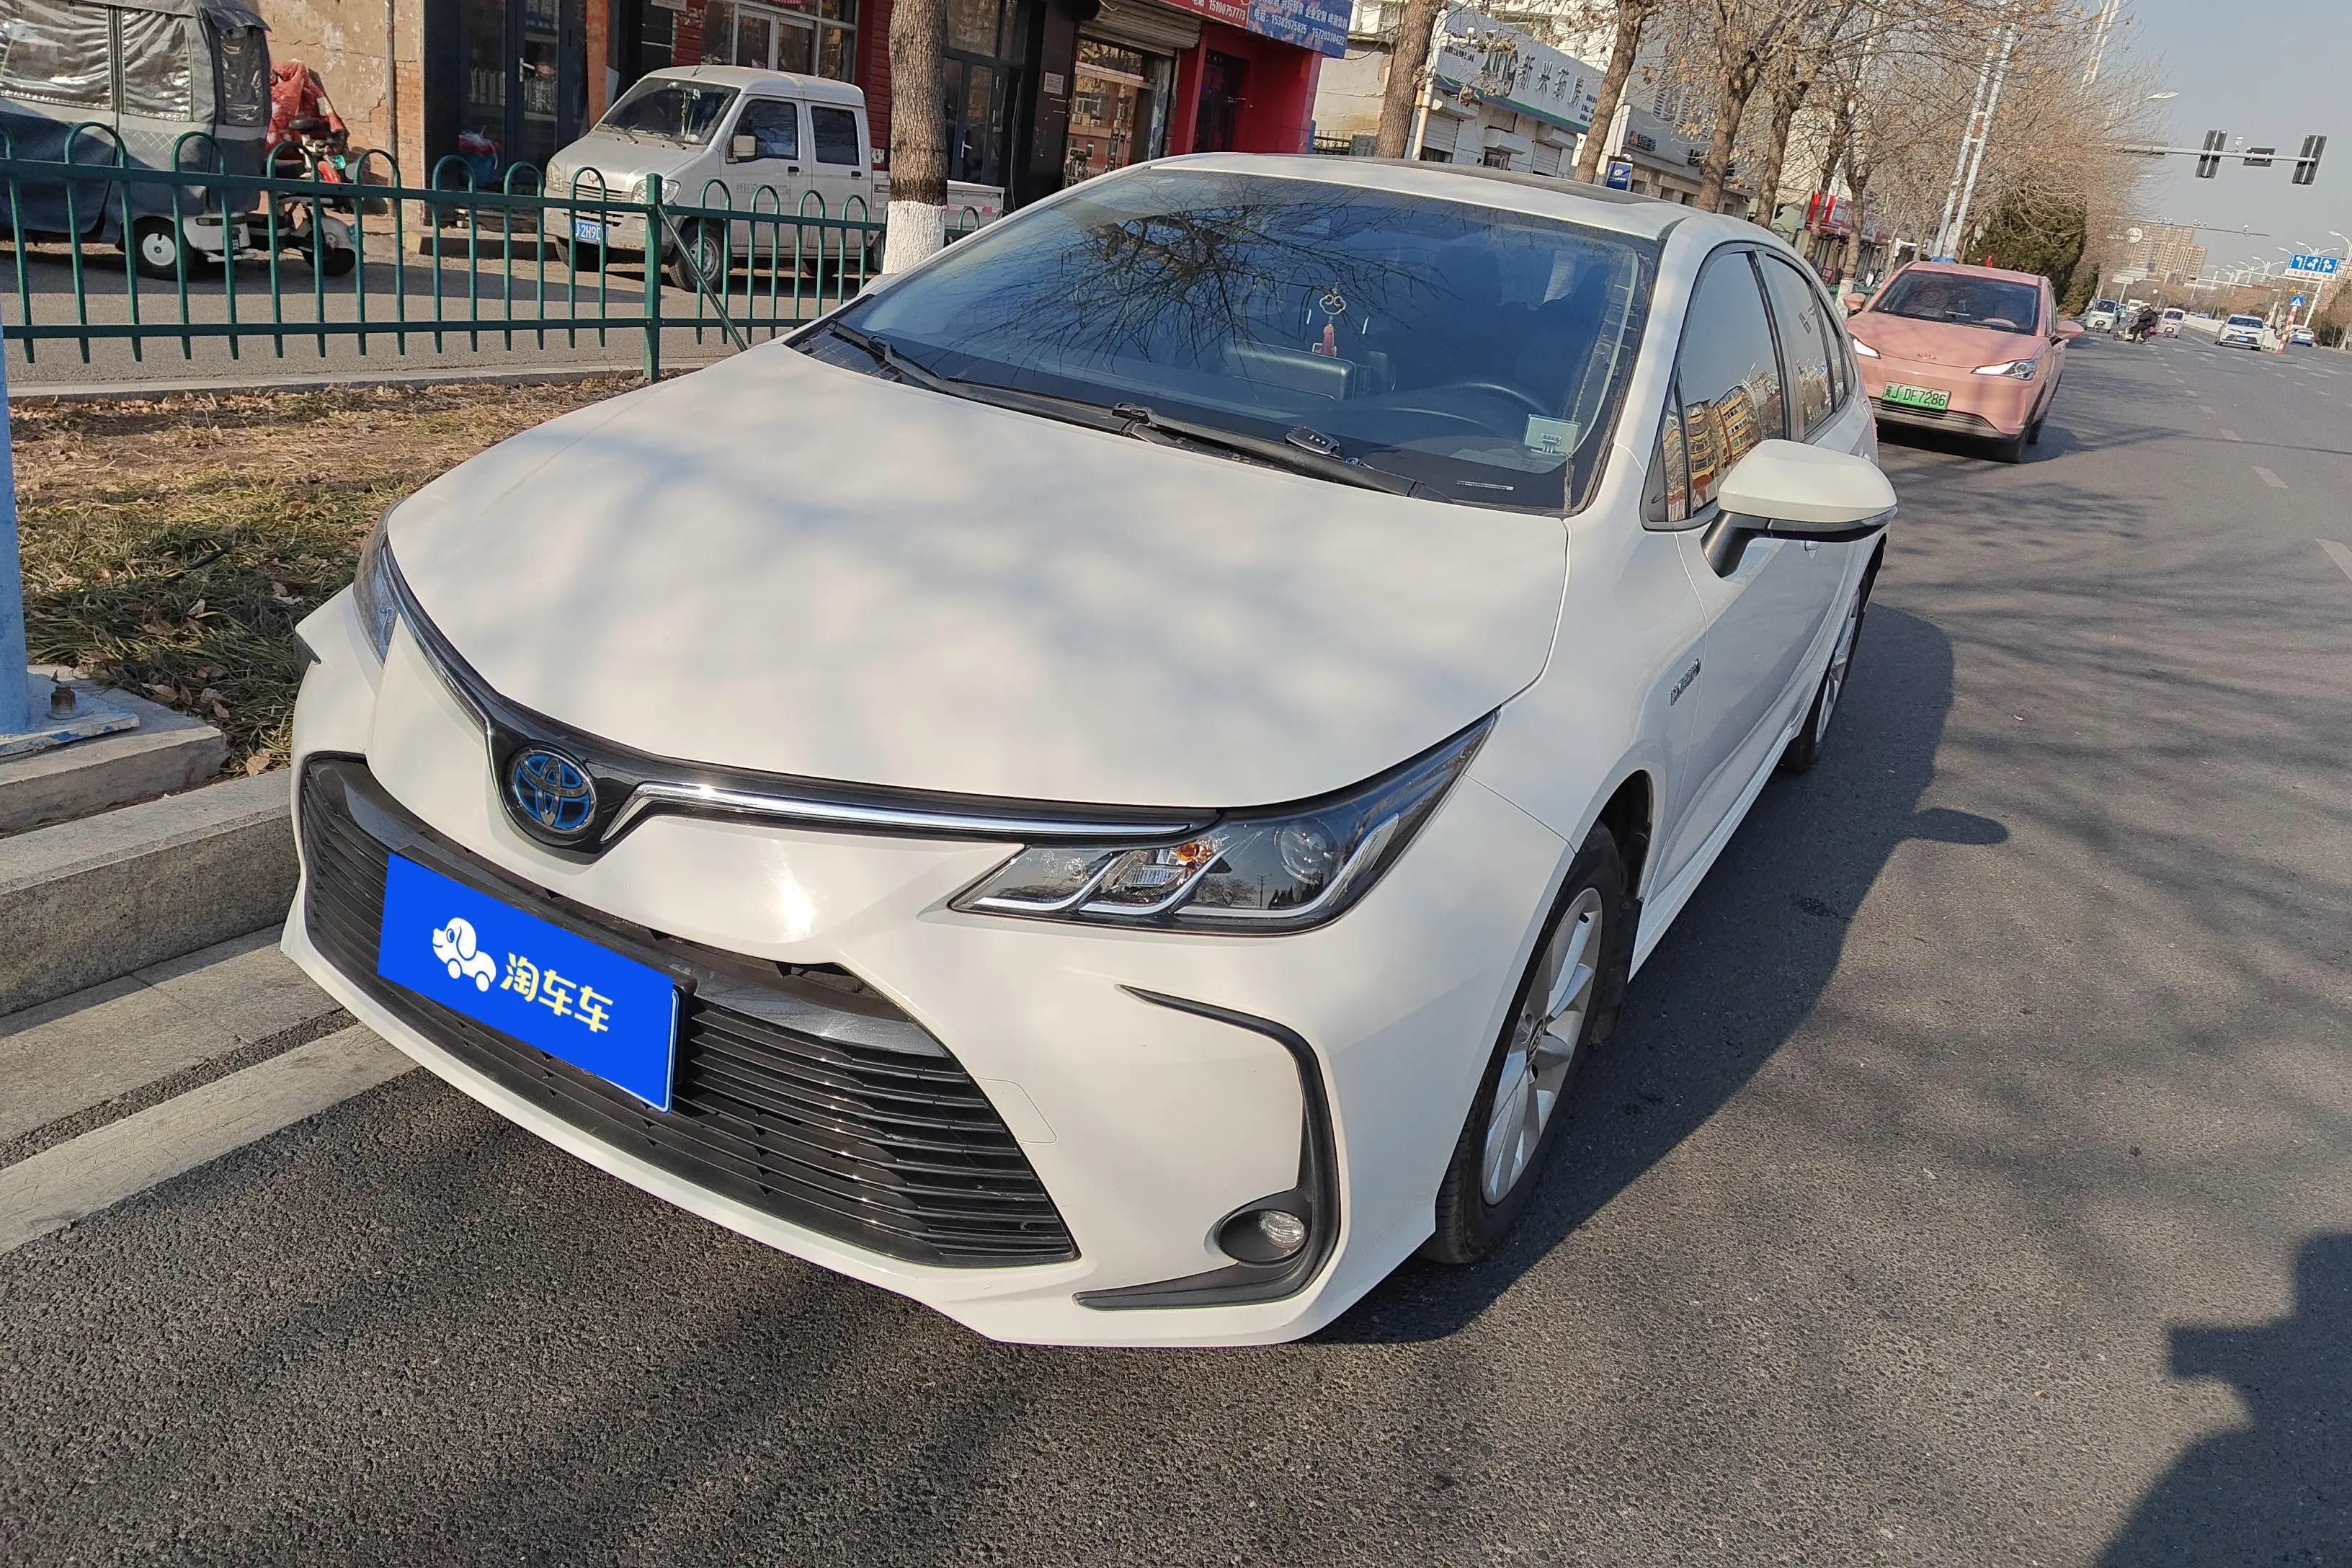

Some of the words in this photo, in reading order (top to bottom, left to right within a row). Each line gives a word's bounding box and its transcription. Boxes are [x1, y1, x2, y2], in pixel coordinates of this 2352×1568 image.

[1305, 6, 1327, 23] 企业定制
[1328, 12, 1348, 31] 啤酒饮料
